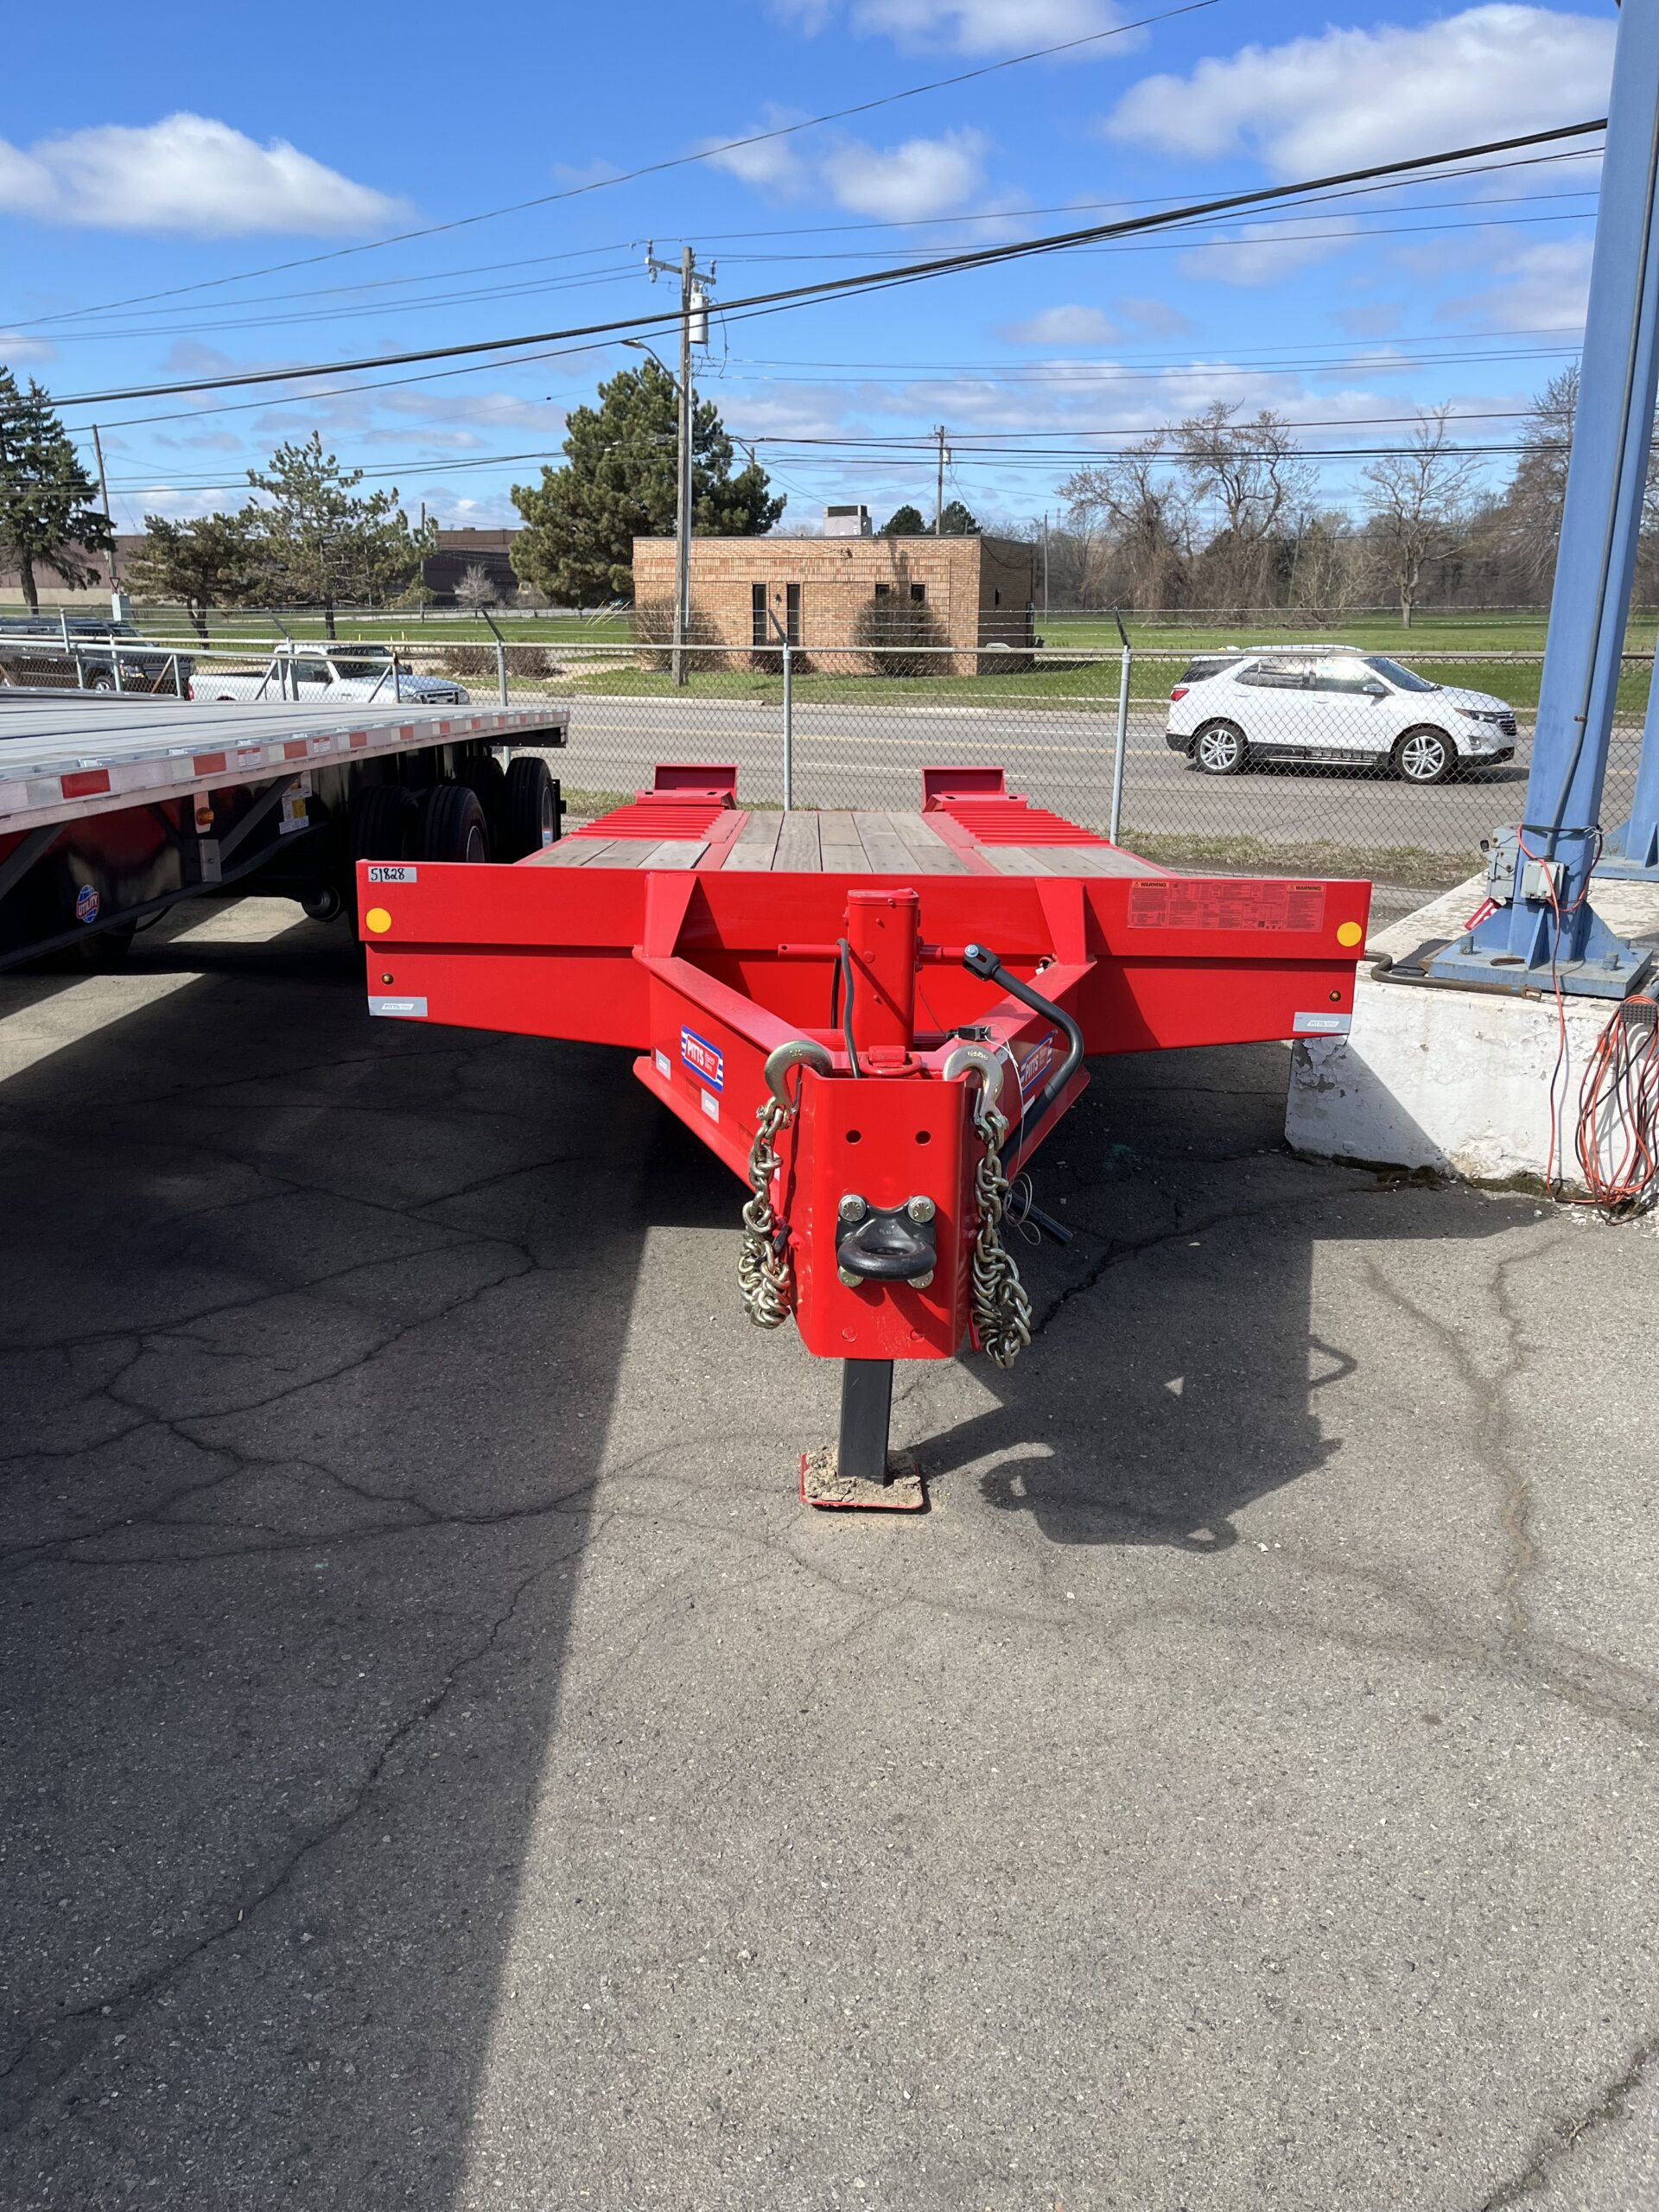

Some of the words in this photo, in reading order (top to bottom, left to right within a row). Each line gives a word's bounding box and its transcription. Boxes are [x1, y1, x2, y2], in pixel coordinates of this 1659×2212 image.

[371, 868, 405, 882] 51828
[79, 894, 99, 917] UTILITY
[687, 1039, 704, 1066] PITTS
[1025, 1054, 1039, 1082] PITTS
